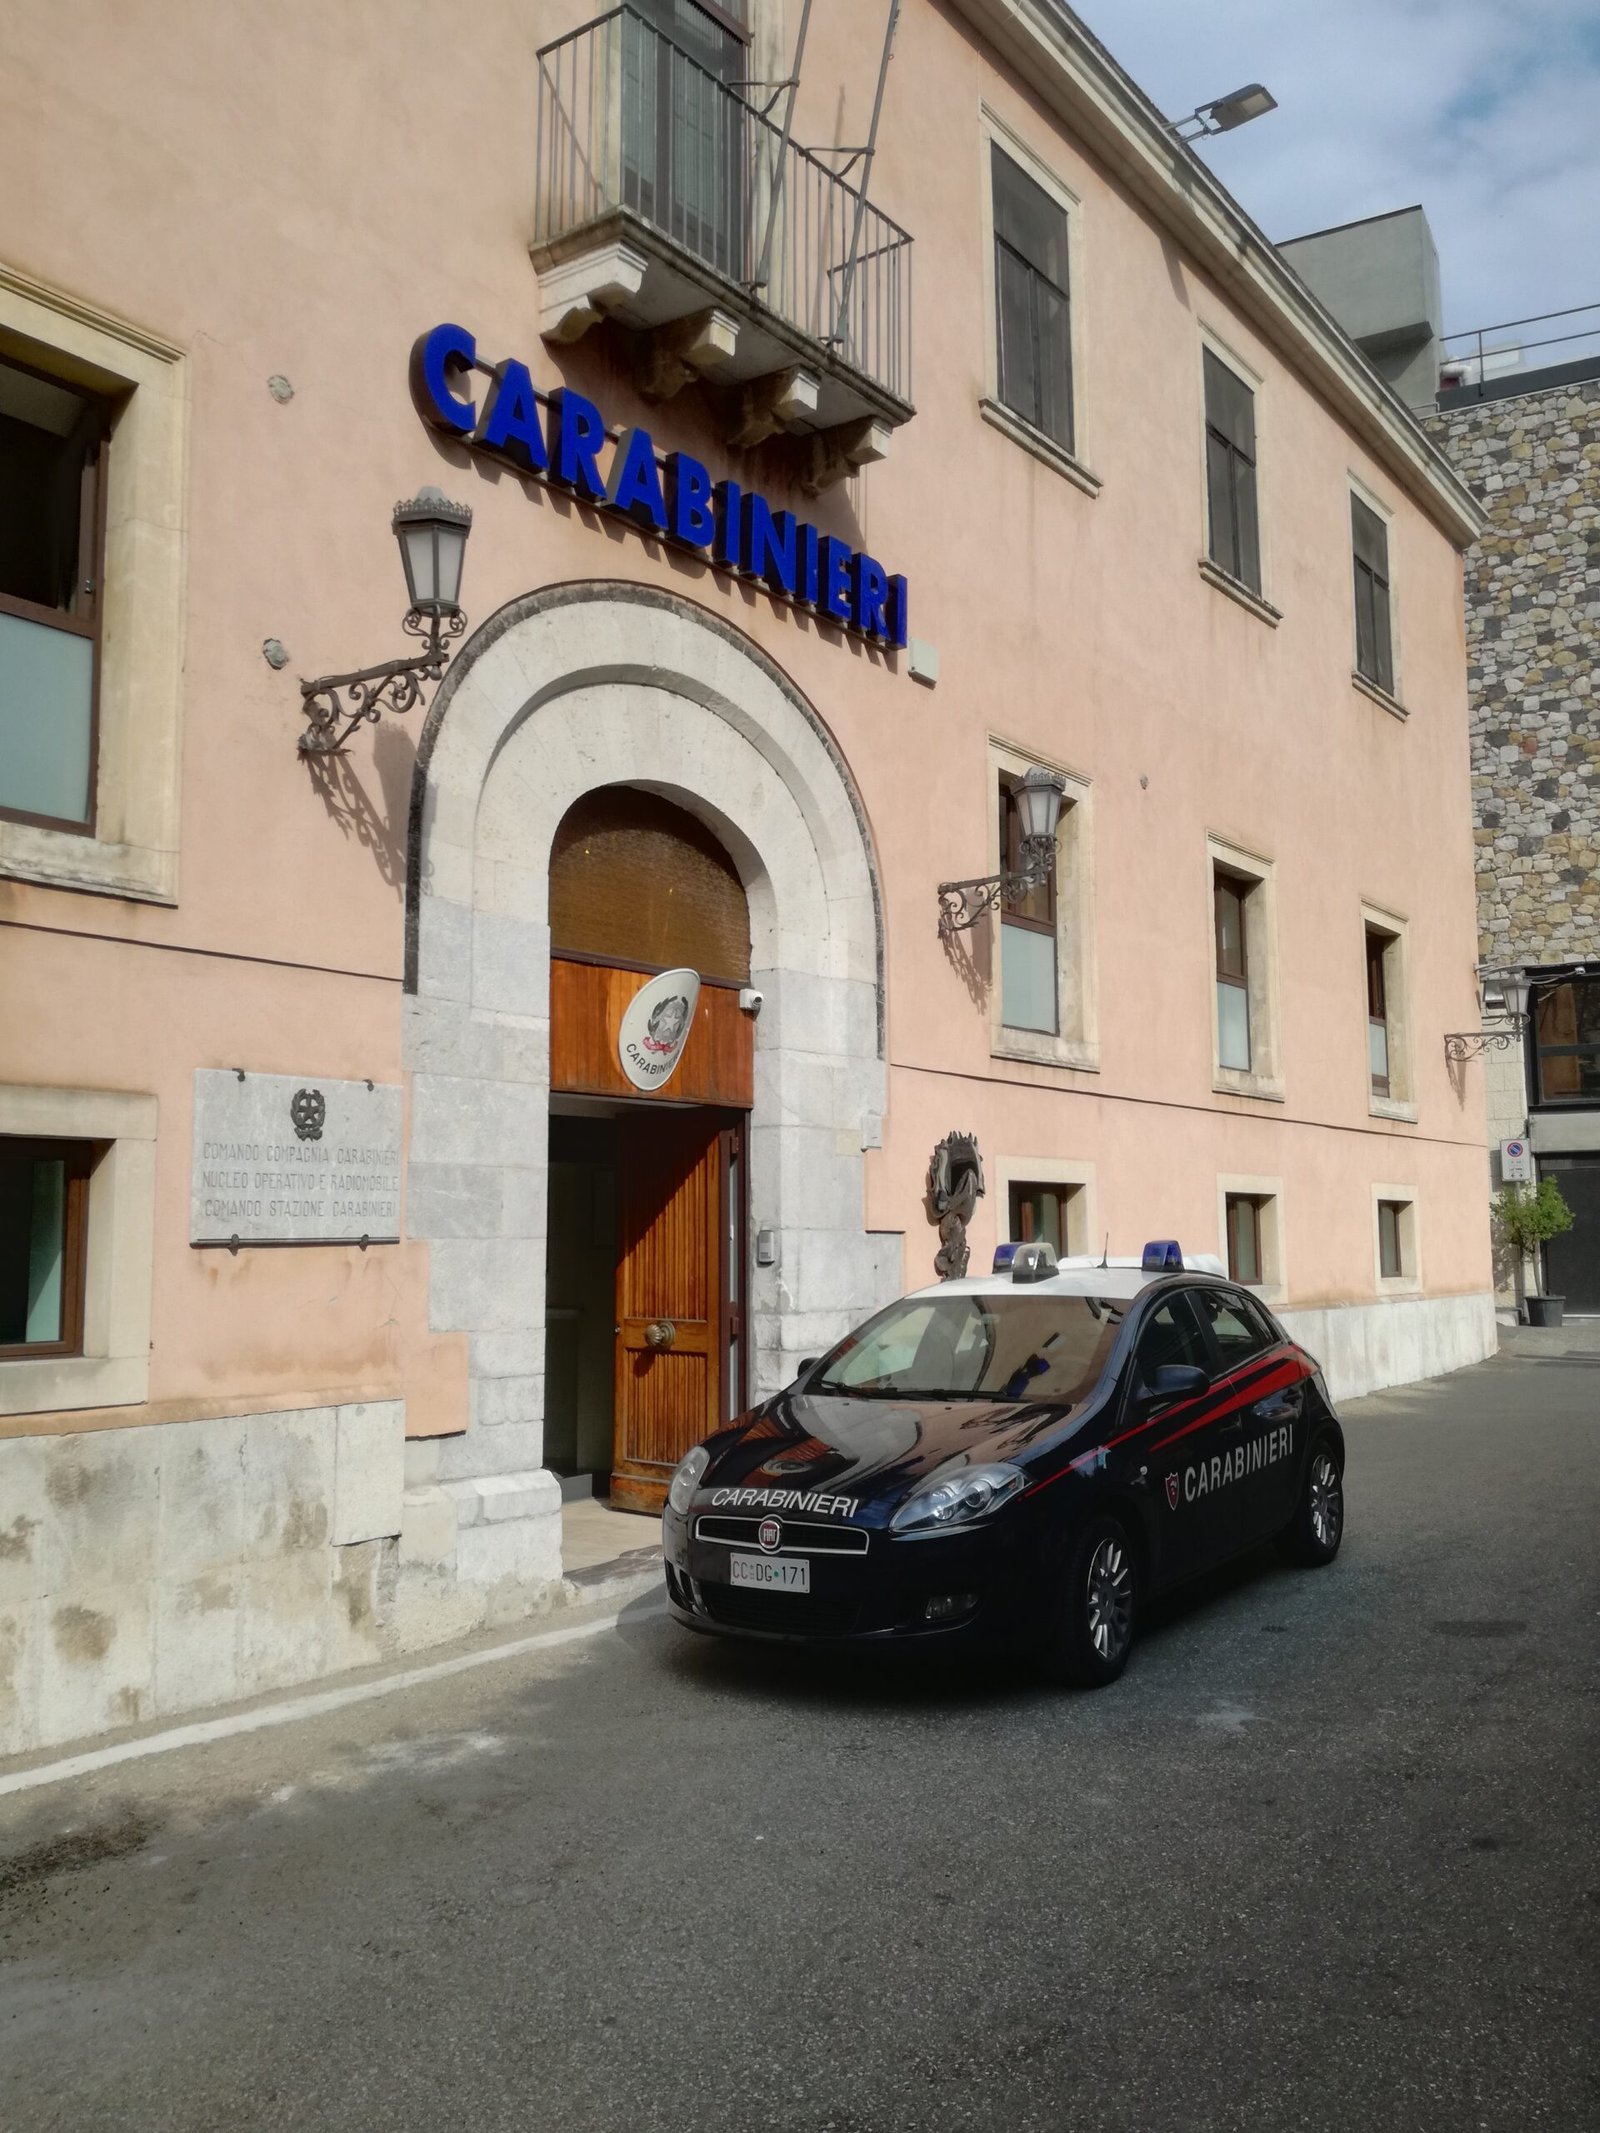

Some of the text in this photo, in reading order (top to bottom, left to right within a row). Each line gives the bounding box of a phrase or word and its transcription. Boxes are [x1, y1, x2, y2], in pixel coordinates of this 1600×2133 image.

[411, 323, 907, 649] CARABINIERI
[203, 1142, 399, 1166] COMANDO COMPAGNIA CARABINIERI
[203, 1171, 399, 1192] NUCLEO OPERATIVO E RADIOMOBILE
[204, 1199, 396, 1218] COMANDO STAZIONE CARABINIERI
[1184, 1423, 1293, 1502] CARABINIERI
[711, 1488, 859, 1518] CARABINIERI
